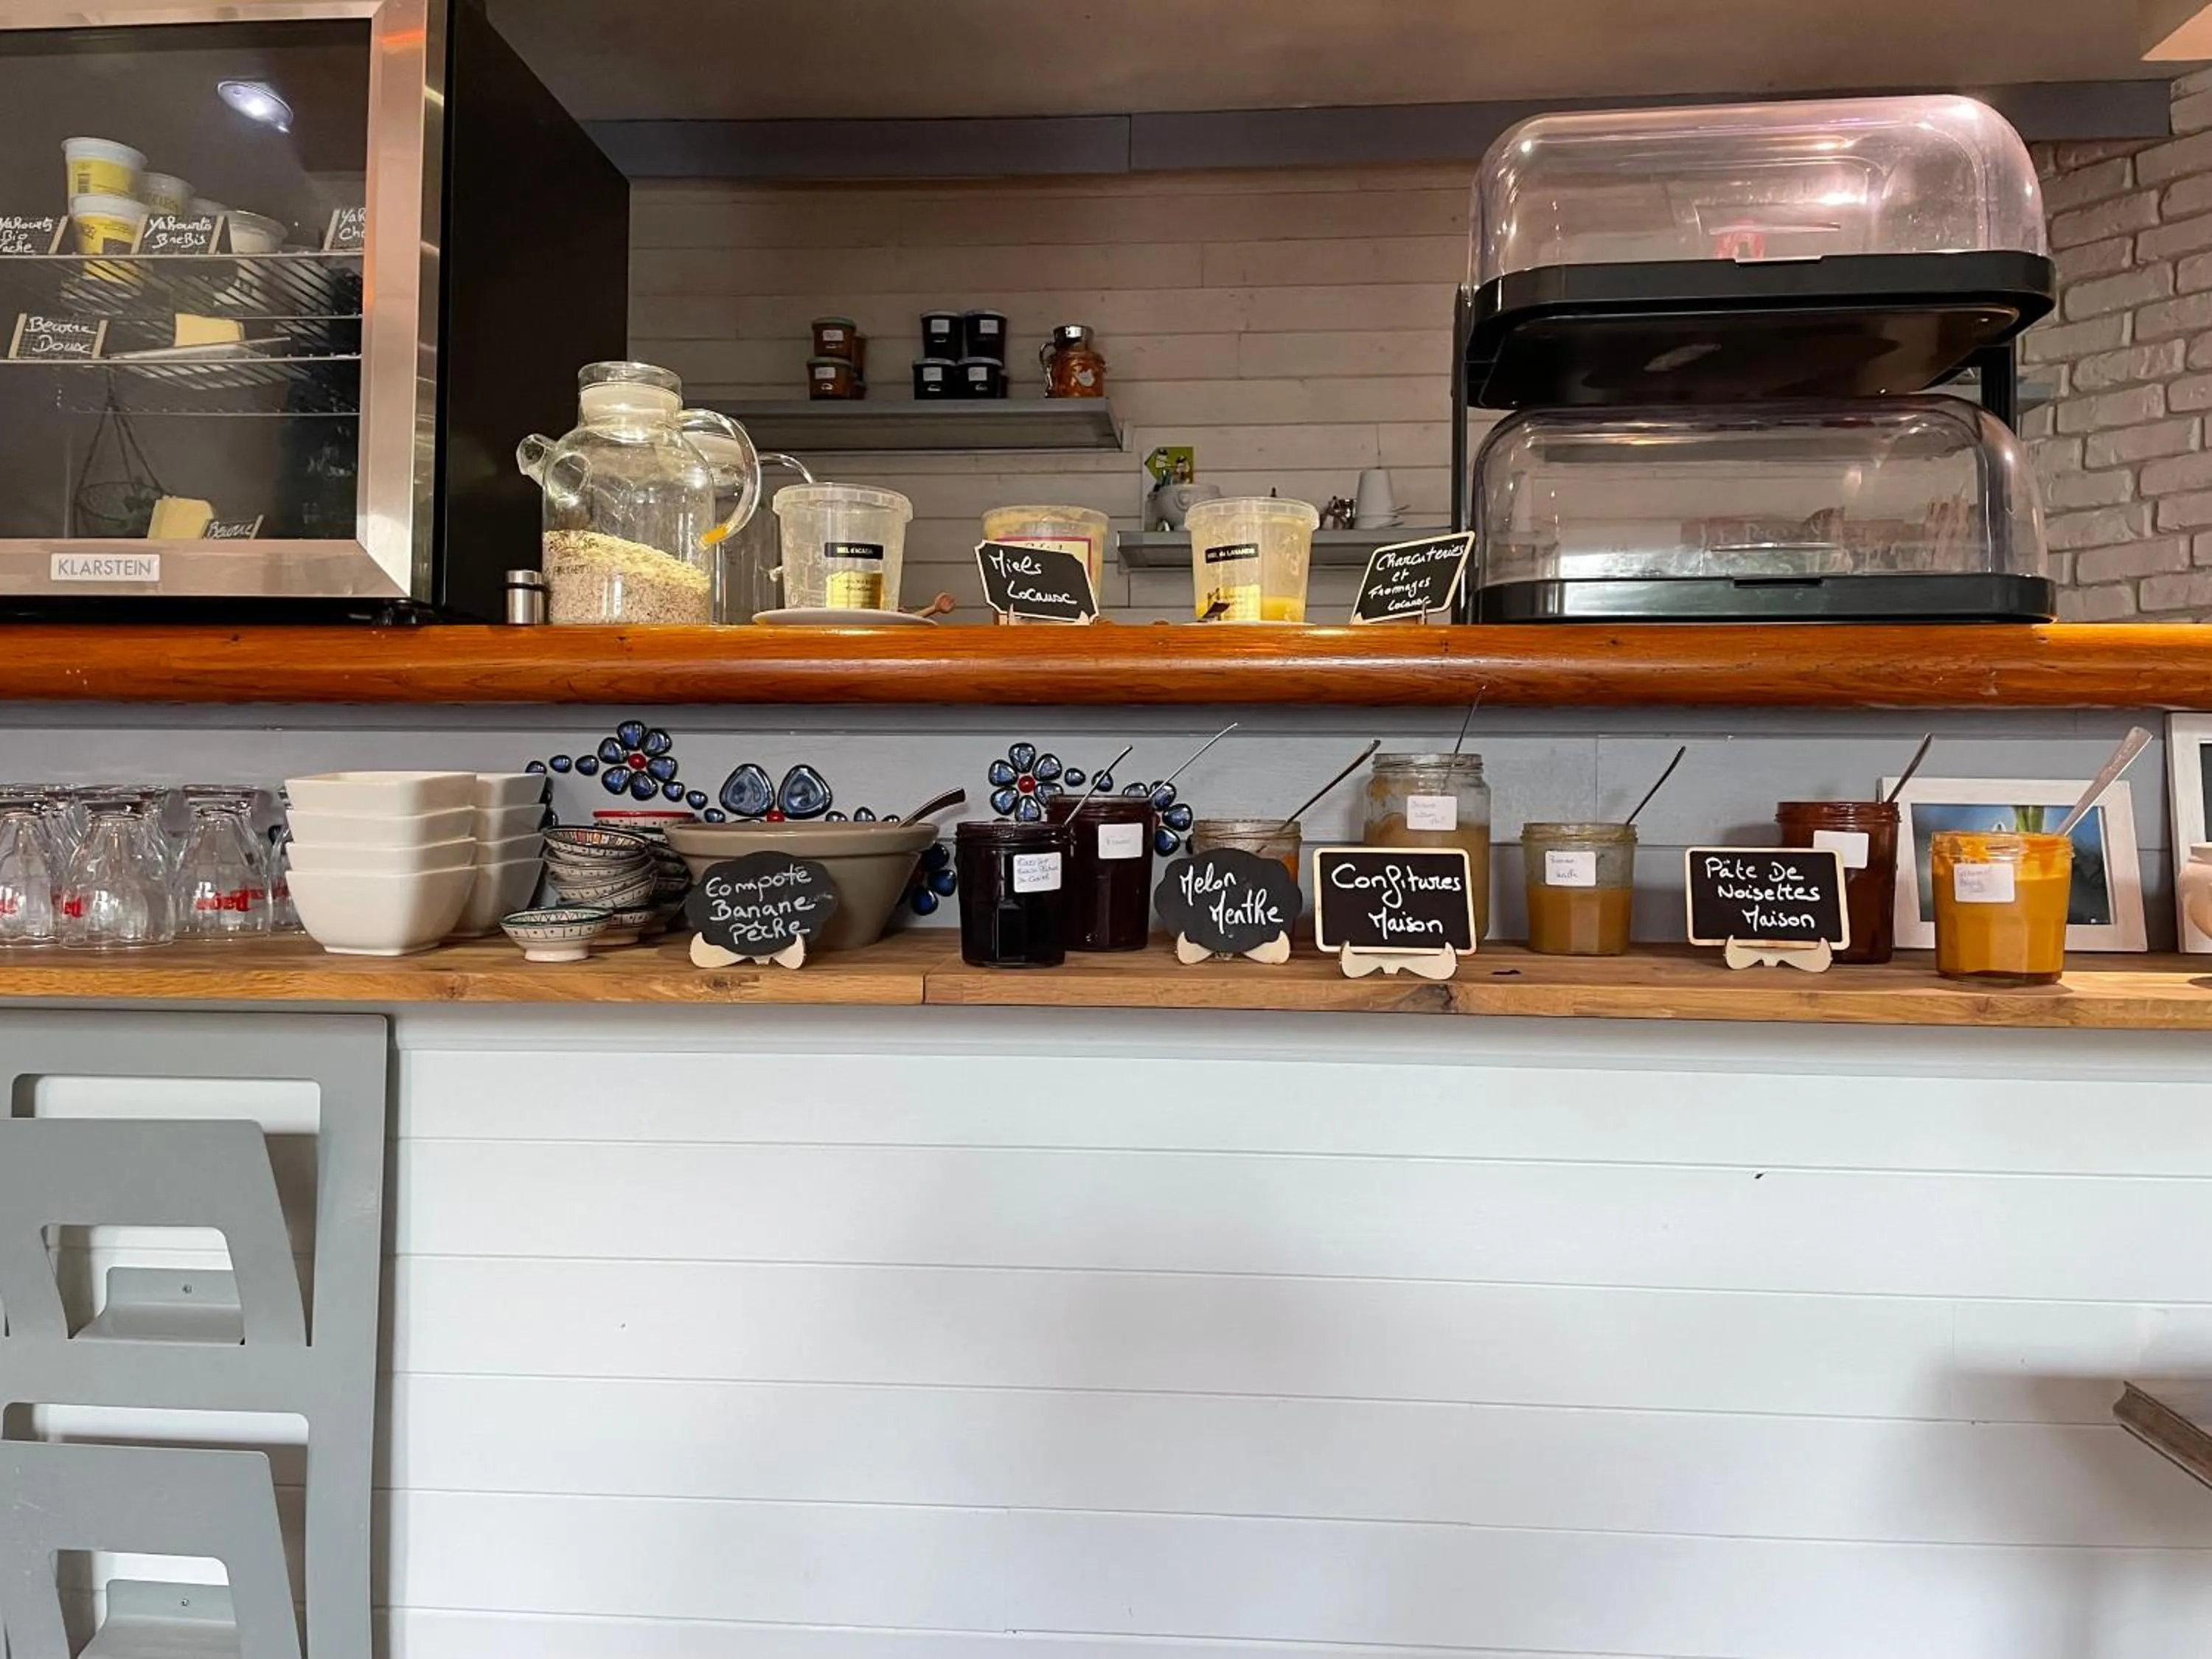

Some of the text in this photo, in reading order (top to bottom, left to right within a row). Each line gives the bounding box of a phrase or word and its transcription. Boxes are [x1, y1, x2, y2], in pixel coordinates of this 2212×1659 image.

[58, 560, 151, 576] KLARSTEIN
[988, 549, 1042, 578] Miels
[1391, 568, 1409, 582] et
[1179, 861, 1237, 906] Melon
[1331, 863, 1462, 909] Confitures
[1717, 883, 1821, 901] Noisettes
[709, 896, 816, 921] Banane
[1208, 888, 1284, 935] Menthe
[1368, 906, 1444, 940] Maison
[1742, 904, 1816, 933] Maison
